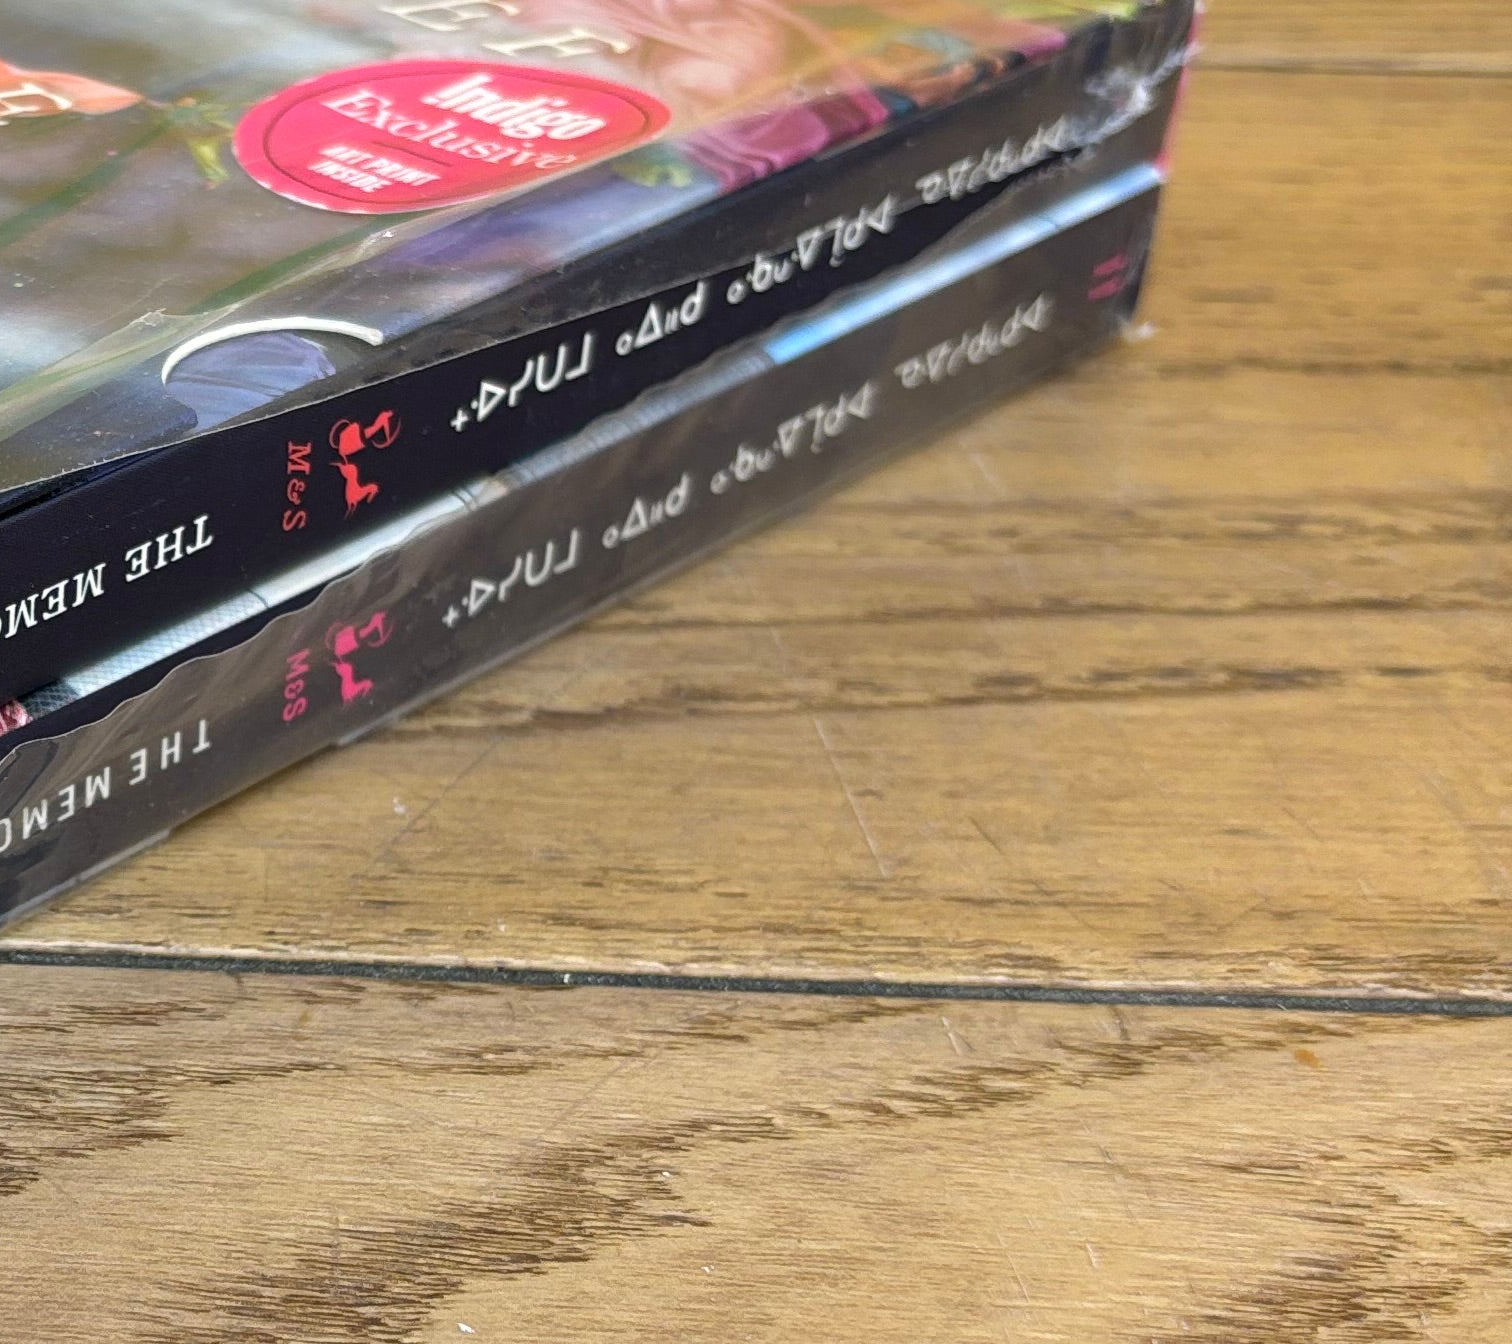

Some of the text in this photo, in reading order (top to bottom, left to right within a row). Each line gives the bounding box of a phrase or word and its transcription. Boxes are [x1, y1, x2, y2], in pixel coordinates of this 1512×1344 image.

[321, 90, 578, 170] Exclusive
[307, 160, 394, 194] INSIDE
[360, 157, 442, 188] PRINT
[282, 440, 313, 533] M&S
[124, 514, 215, 582] THE
[282, 648, 312, 723] M&S
[128, 718, 213, 787] THE
